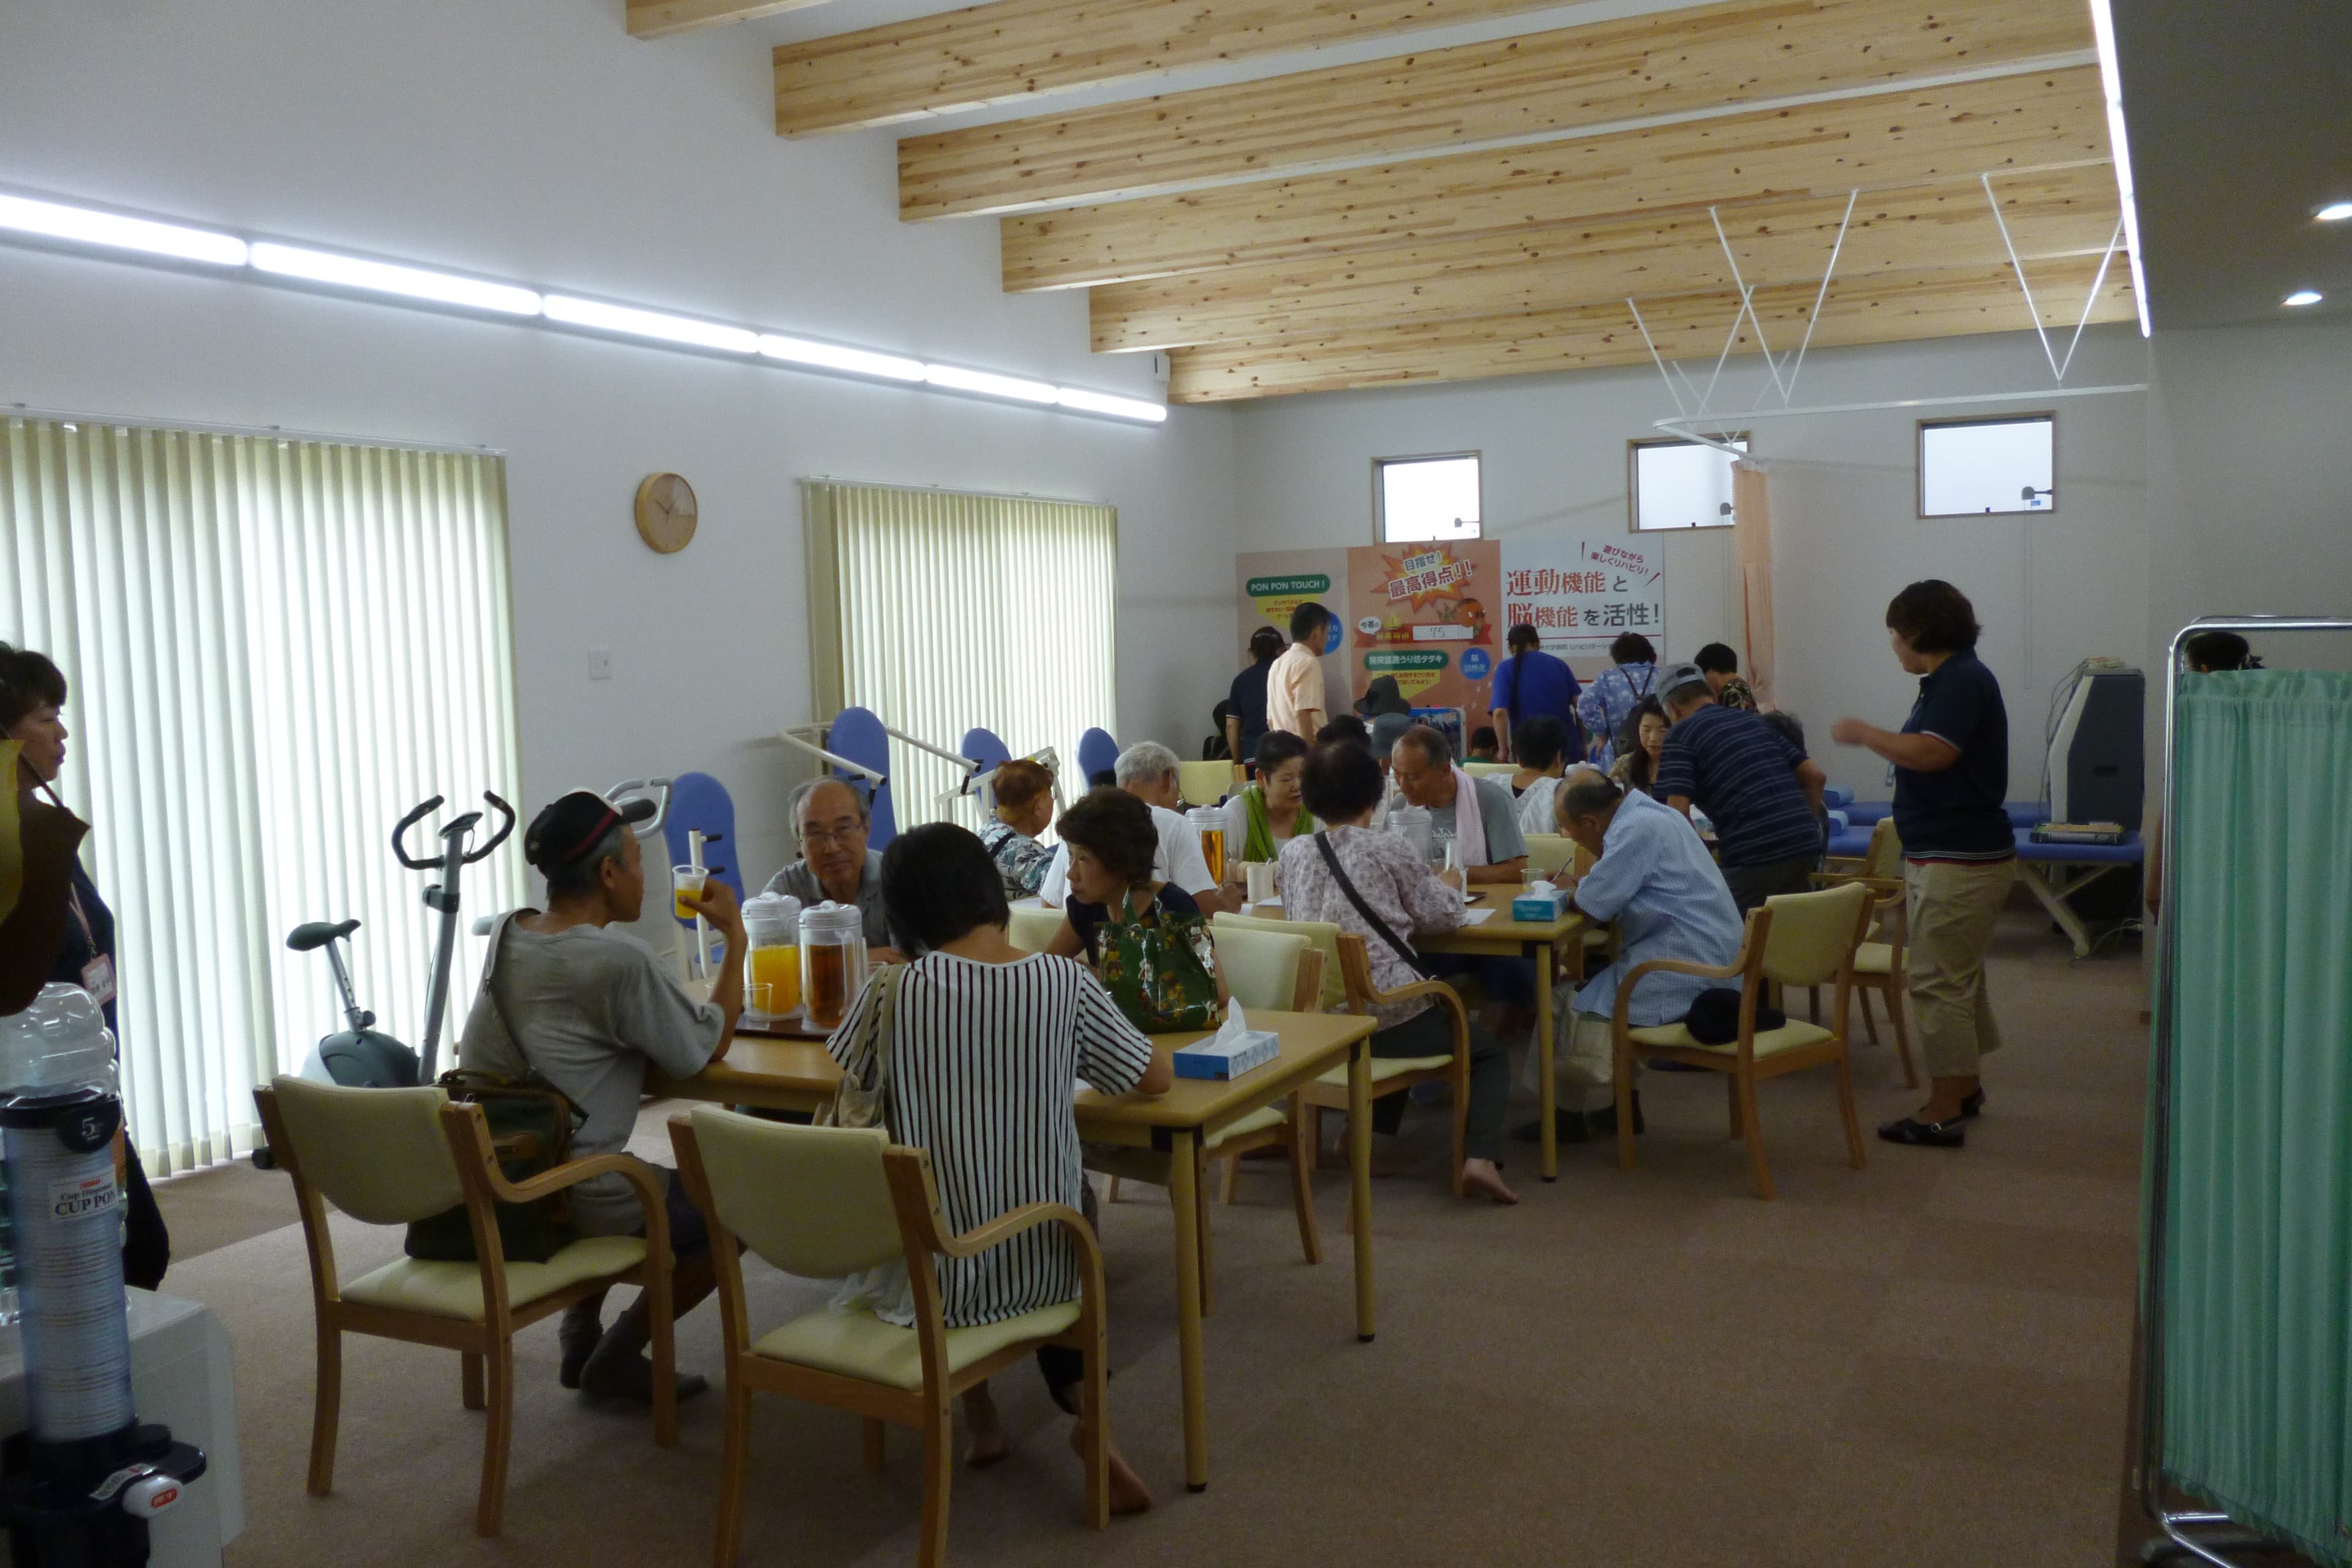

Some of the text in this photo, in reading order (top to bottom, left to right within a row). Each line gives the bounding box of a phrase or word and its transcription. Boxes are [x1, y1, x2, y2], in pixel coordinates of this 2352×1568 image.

[1251, 583, 1268, 592] PON
[1270, 582, 1288, 590] PON
[55, 1197, 92, 1216] CUP
